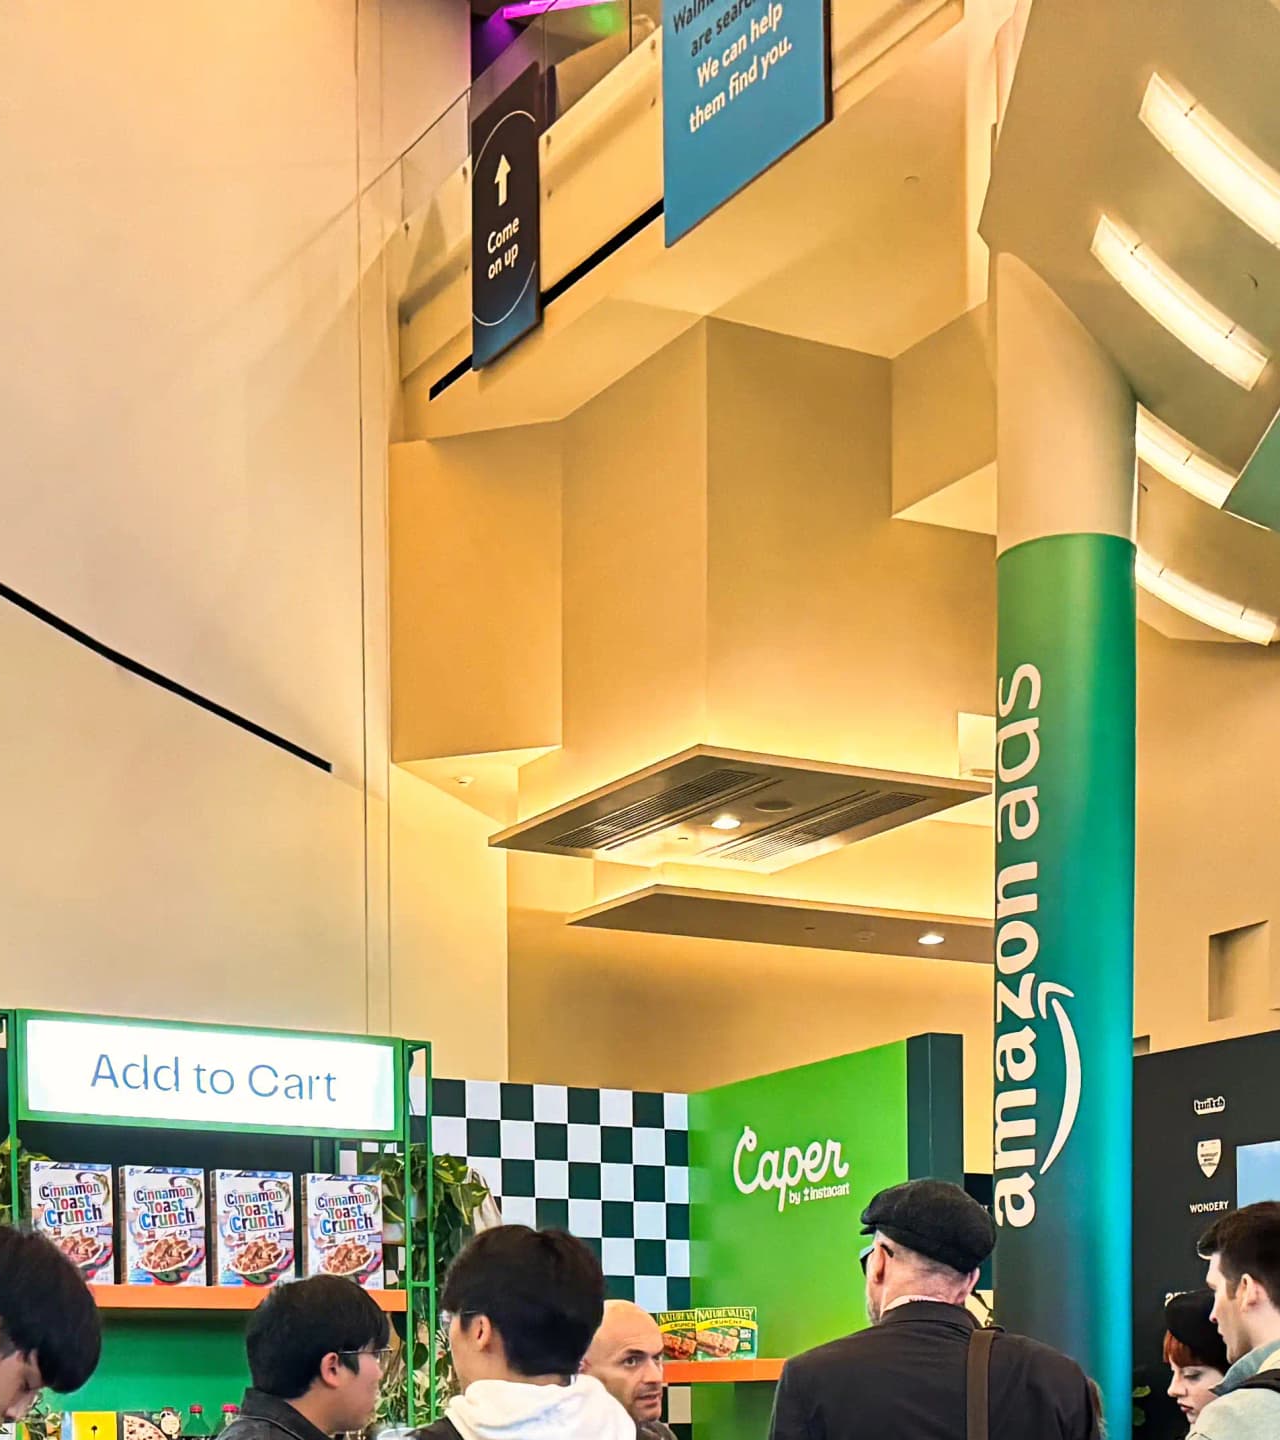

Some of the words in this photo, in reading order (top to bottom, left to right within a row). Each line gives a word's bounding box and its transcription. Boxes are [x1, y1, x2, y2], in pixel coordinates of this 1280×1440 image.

[691, 27, 712, 57] are
[716, 0, 757, 35] searc
[697, 56, 719, 88] We
[722, 34, 747, 67] can
[750, 3, 783, 44] help
[689, 91, 726, 133] them
[728, 55, 758, 101] find
[761, 36, 793, 80] you.
[487, 216, 520, 254] Come
[488, 256, 503, 280] on
[504, 243, 519, 268] up
[993, 860, 1040, 1228] amazon
[89, 1053, 182, 1092] Add
[192, 1063, 236, 1097] to
[247, 1064, 339, 1103] Cart
[733, 1125, 850, 1212] Caper
[41, 1182, 101, 1198] Cinnamon
[136, 1185, 193, 1202] Cinnamon
[226, 1188, 282, 1205] Cinnamon
[317, 1192, 371, 1208] Cinnamon
[788, 1190, 801, 1205] by
[809, 1182, 850, 1200] instacart
[53, 1194, 91, 1210] Toast
[149, 1198, 185, 1214] Toast
[238, 1201, 273, 1217] Toast
[329, 1204, 363, 1220] Toast
[1189, 1201, 1229, 1213] WONDERY
[46, 1203, 102, 1225] Crunch
[140, 1208, 195, 1229] Crunch
[231, 1211, 284, 1231] Crunch
[320, 1214, 373, 1234] Crunch
[698, 1310, 727, 1323] NATURE
[727, 1308, 754, 1320] VALLEY
